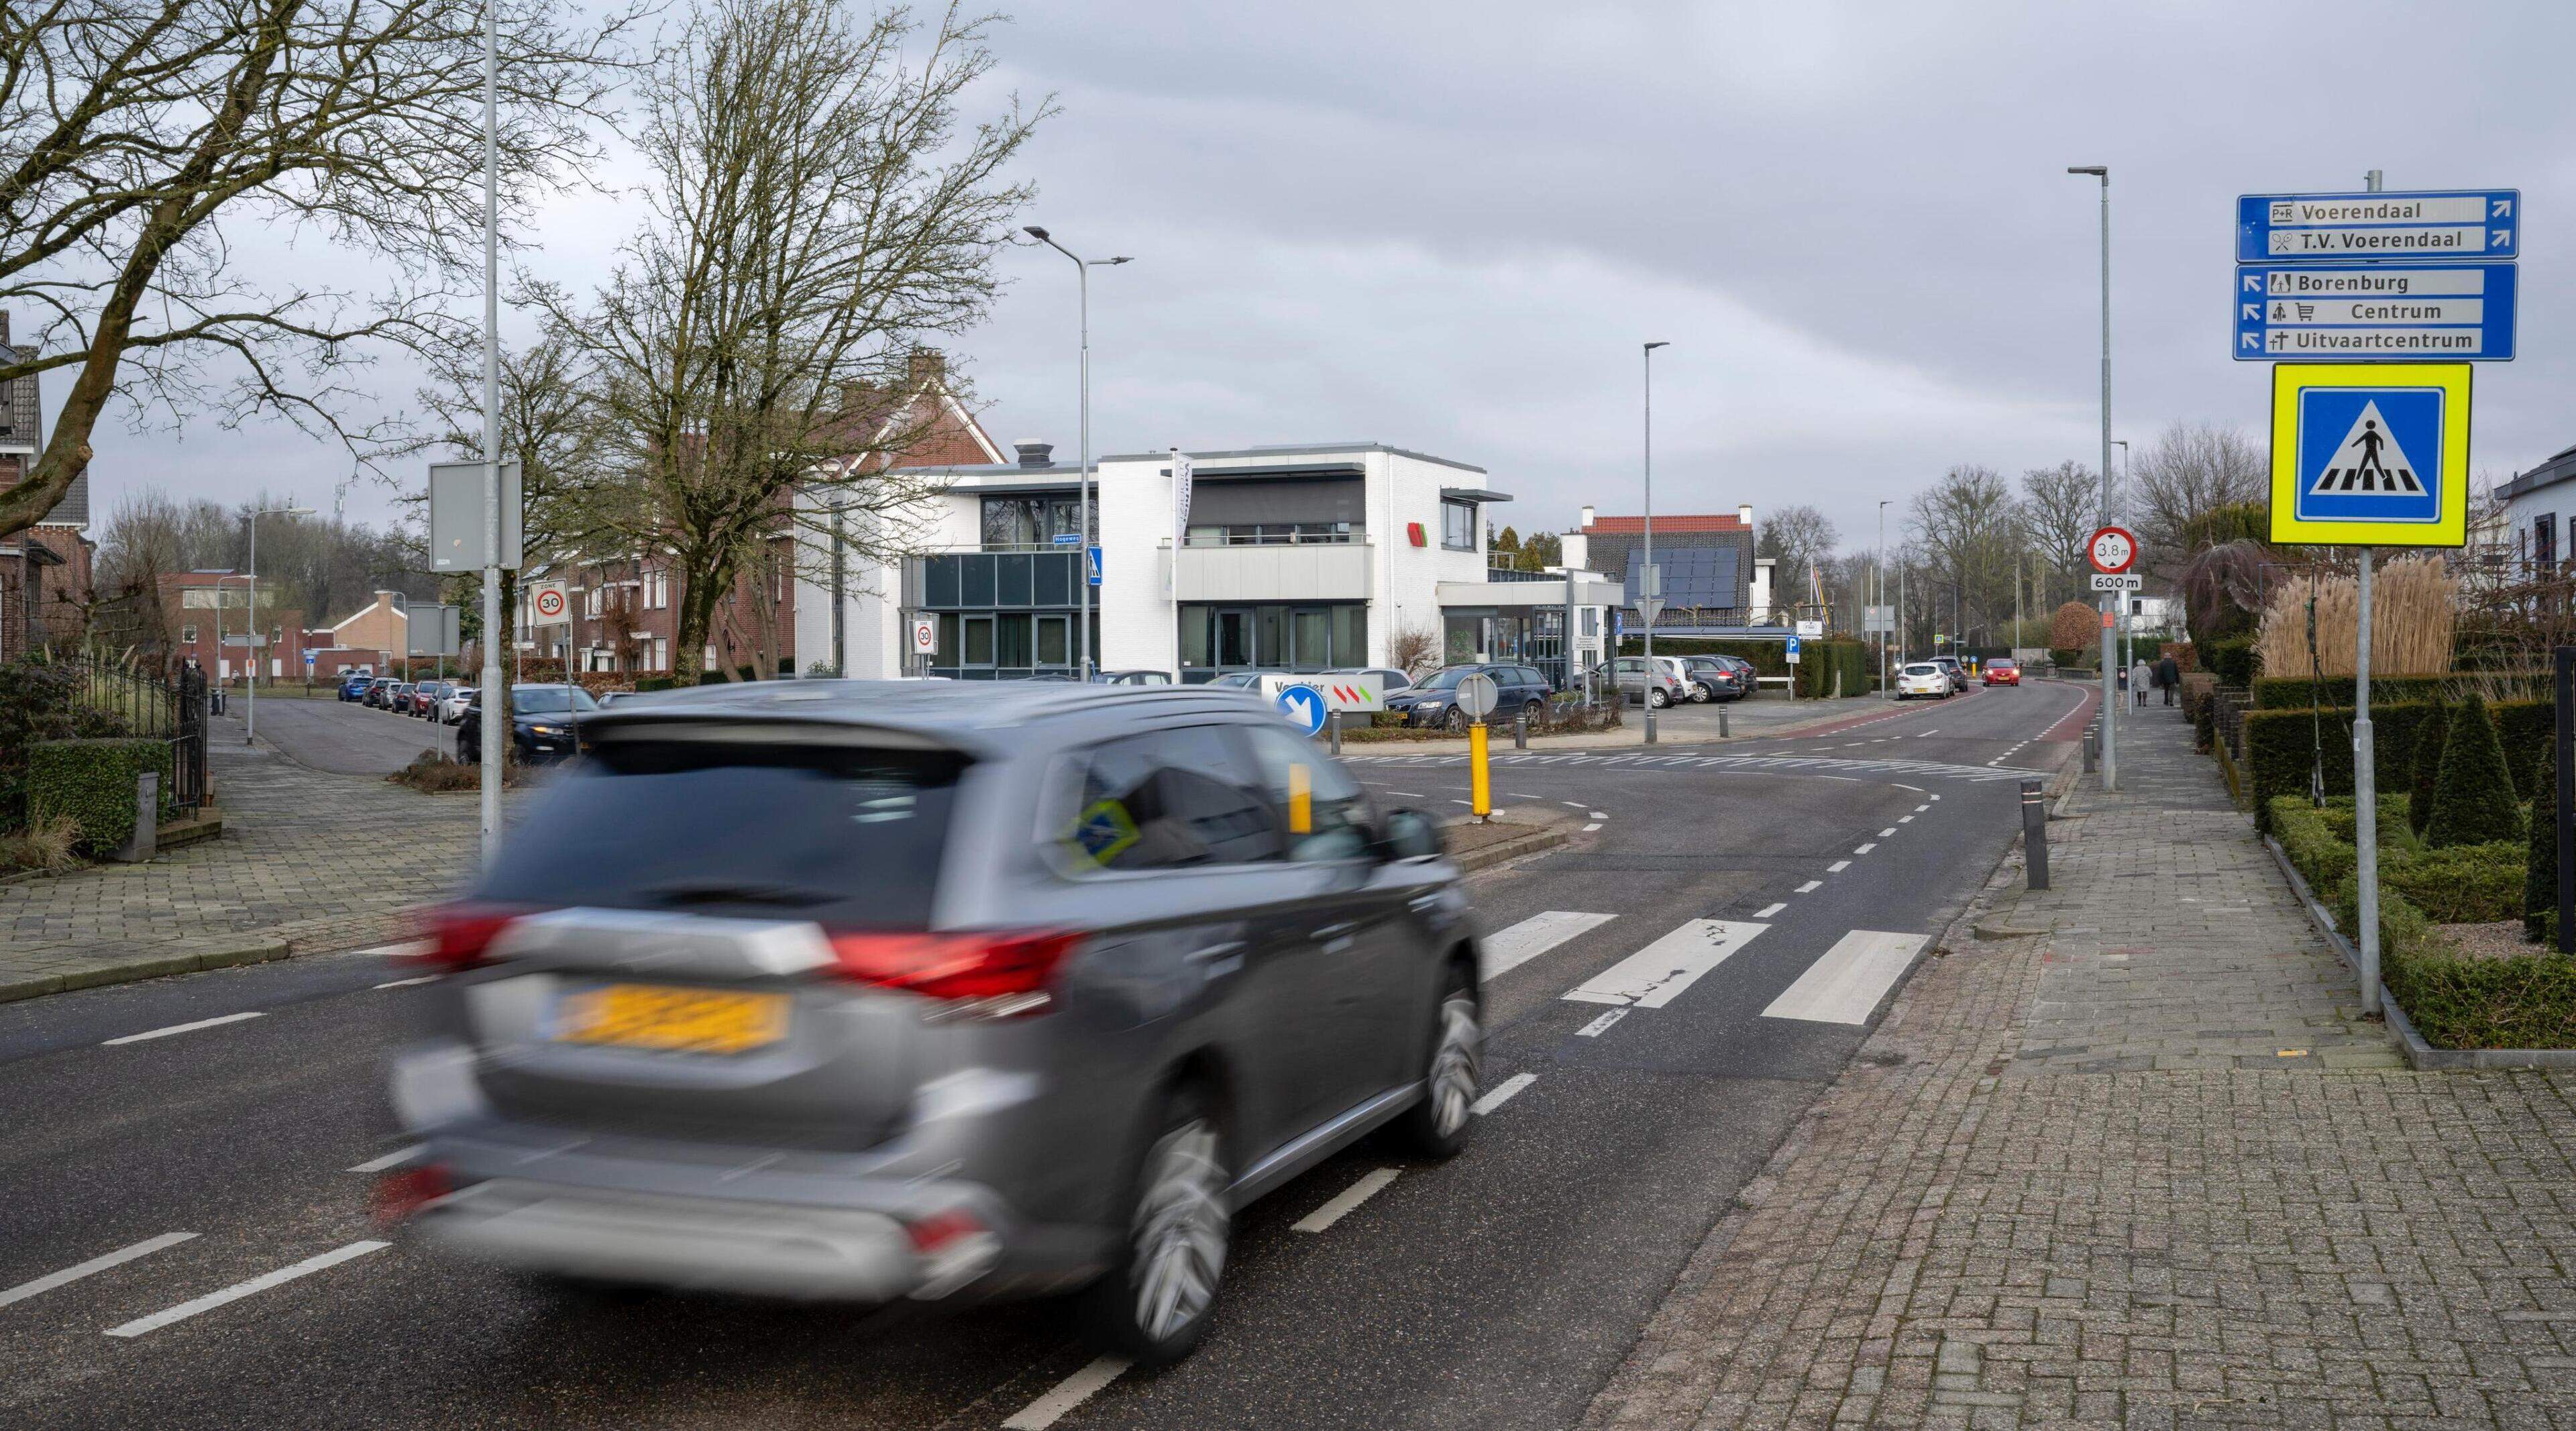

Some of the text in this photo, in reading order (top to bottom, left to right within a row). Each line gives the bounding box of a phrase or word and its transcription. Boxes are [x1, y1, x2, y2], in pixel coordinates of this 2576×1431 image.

[2272, 203, 2420, 220] P+R Voerendaal
[2301, 231, 2462, 249] T.V. Voerendaal
[2298, 275, 2408, 294] Borenburg
[2351, 304, 2441, 319] Centrum
[2296, 333, 2473, 348] Uitvaartcentrum
[2096, 578, 2123, 588] 600
[543, 598, 559, 608] 30
[1790, 638, 1796, 651] P
